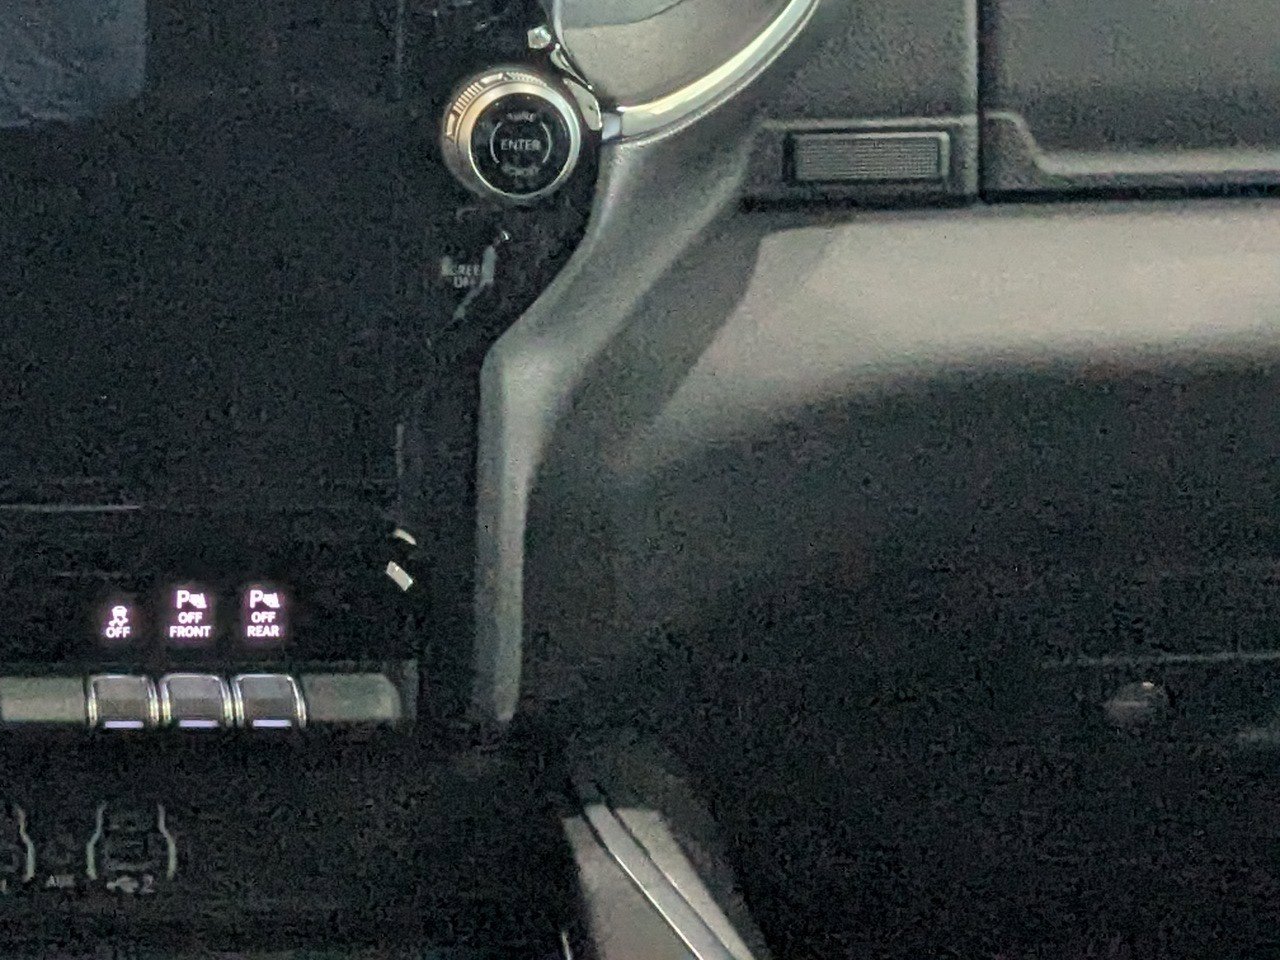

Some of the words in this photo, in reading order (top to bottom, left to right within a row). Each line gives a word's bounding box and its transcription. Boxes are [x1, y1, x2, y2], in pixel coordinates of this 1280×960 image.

[500, 138, 541, 151] ENTER
[178, 612, 203, 623] OFF
[251, 612, 276, 623] OFF
[105, 627, 130, 638] OFF
[169, 626, 211, 637] FRONT
[247, 626, 280, 637] REAR
